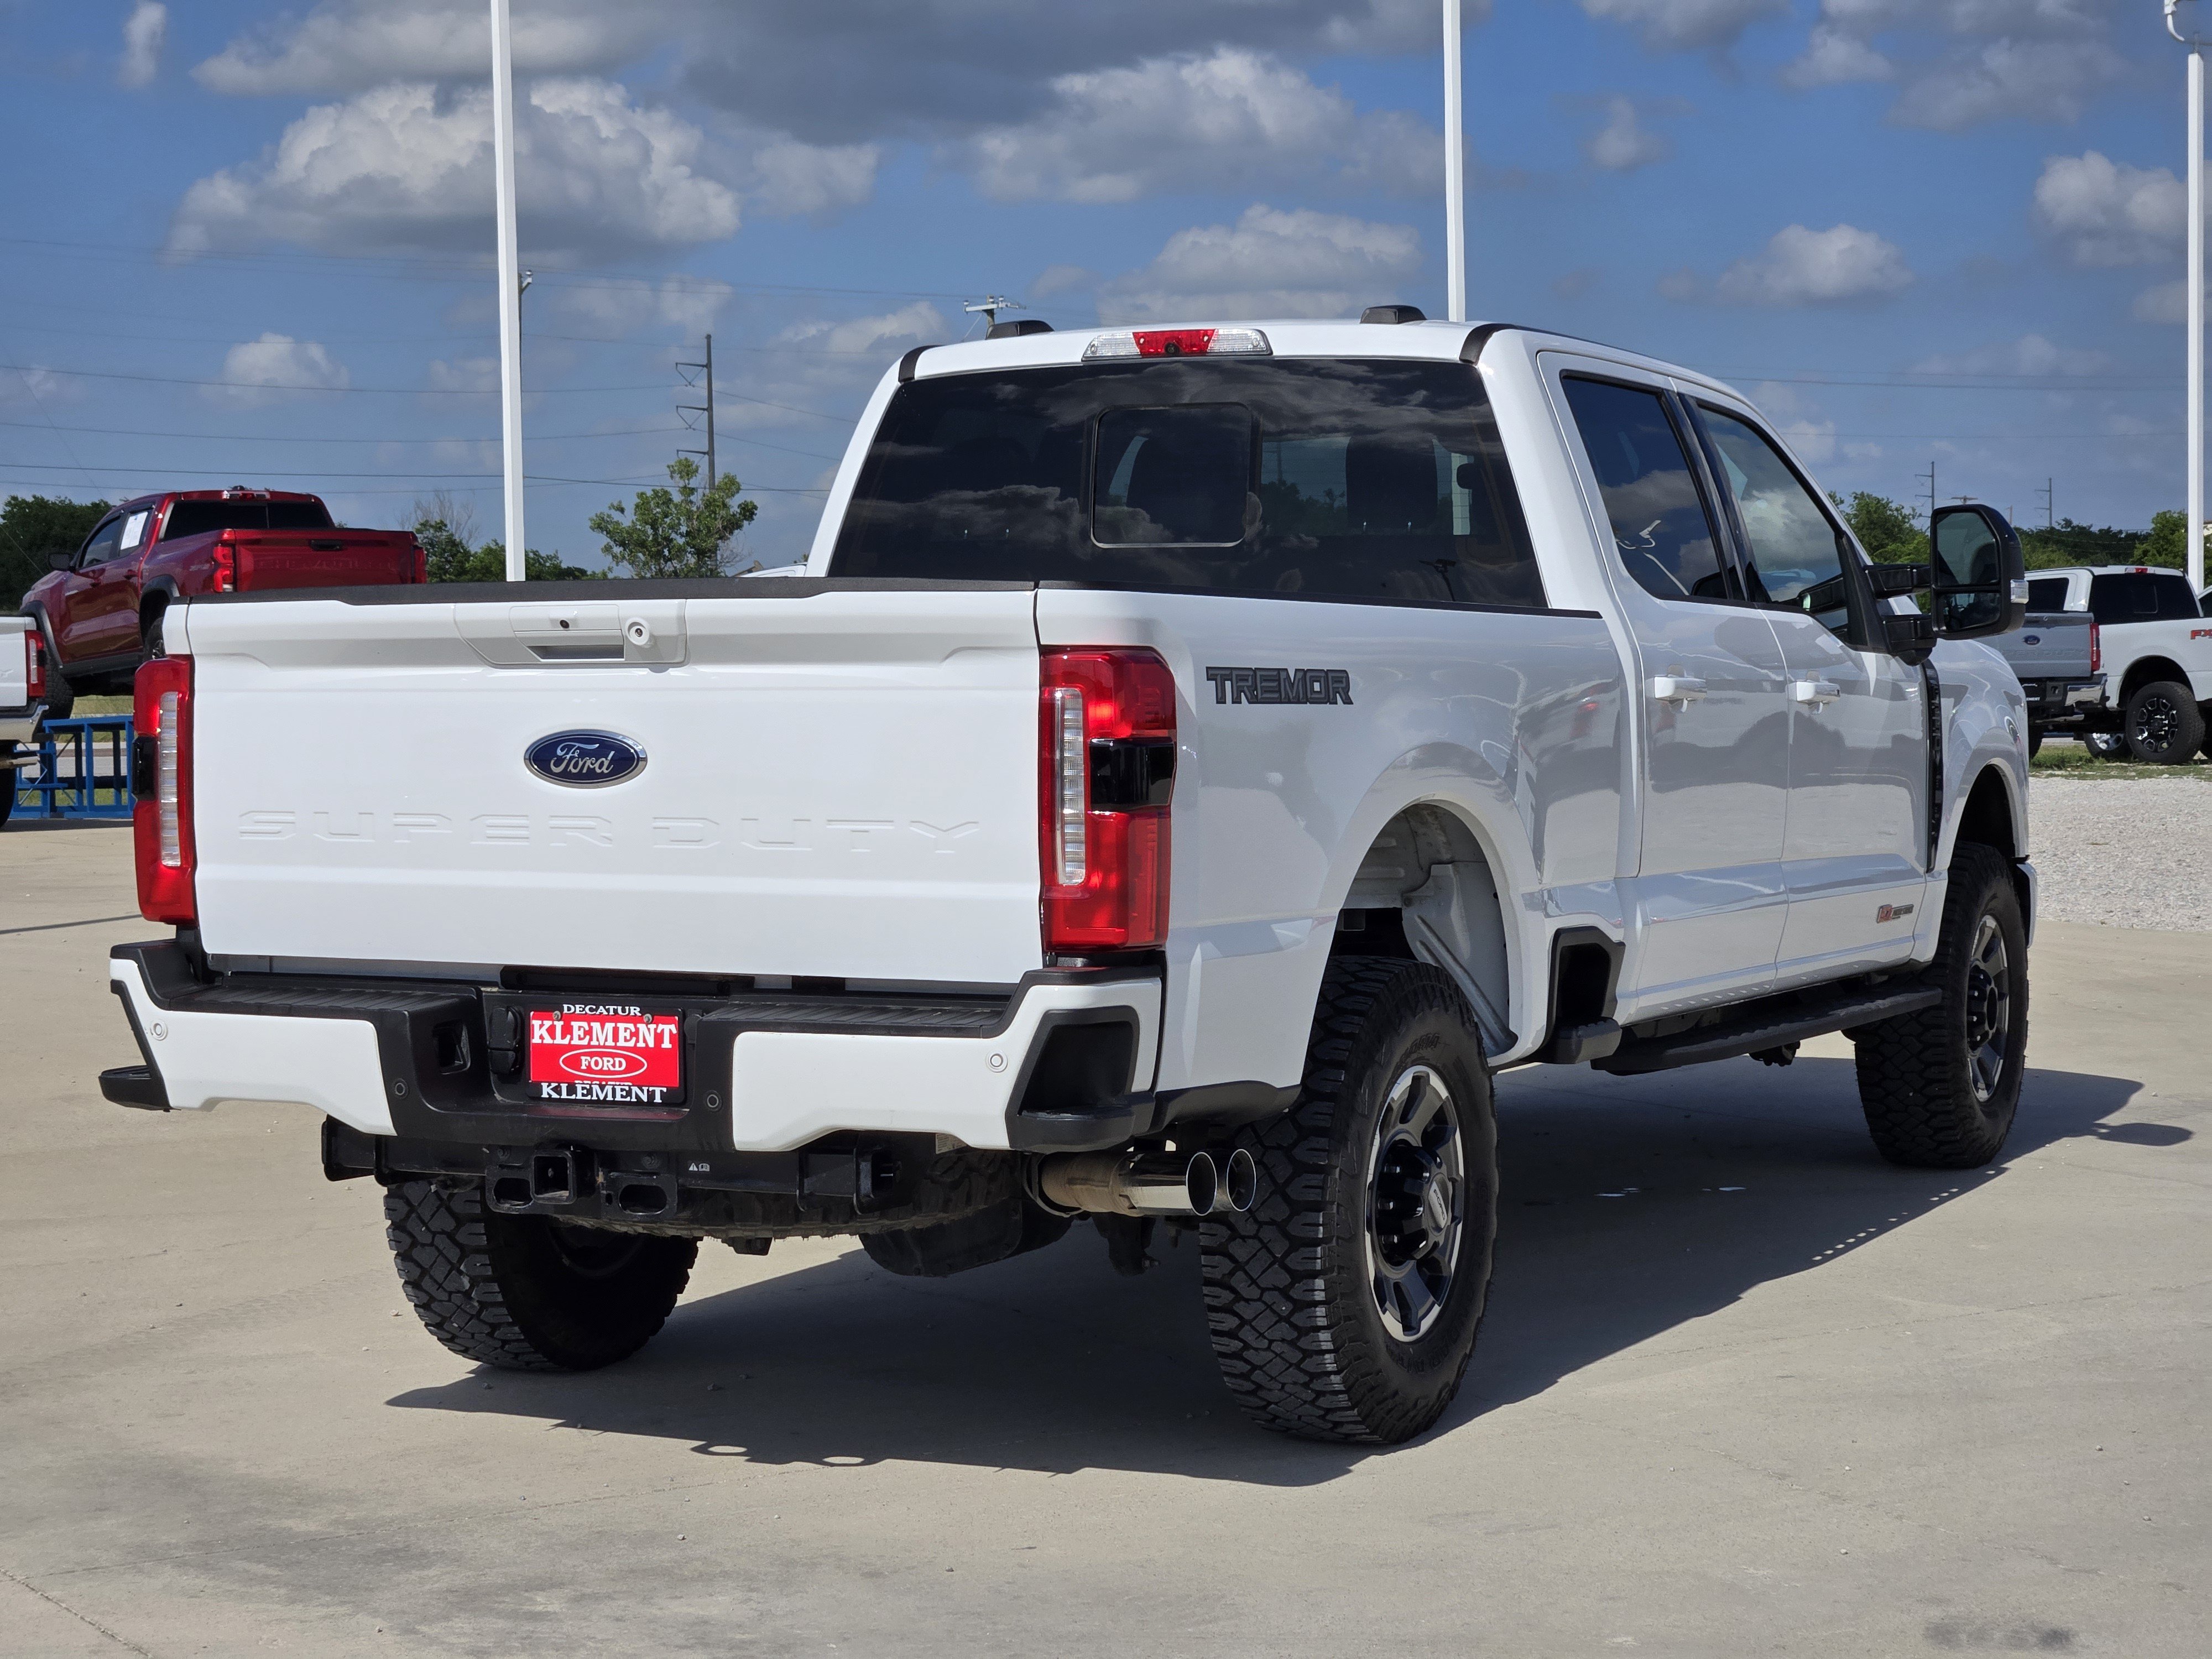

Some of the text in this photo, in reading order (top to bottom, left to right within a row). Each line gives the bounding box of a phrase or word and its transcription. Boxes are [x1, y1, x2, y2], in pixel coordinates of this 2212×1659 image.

[1206, 666, 1354, 705] TREMOR
[550, 742, 615, 773] Ford
[238, 811, 979, 853] SUPER DUTY
[563, 1004, 641, 1016] DECATUR
[531, 1019, 677, 1048] KLEMENT
[581, 1056, 626, 1071] FORD
[541, 1083, 666, 1103] KLEMENT
